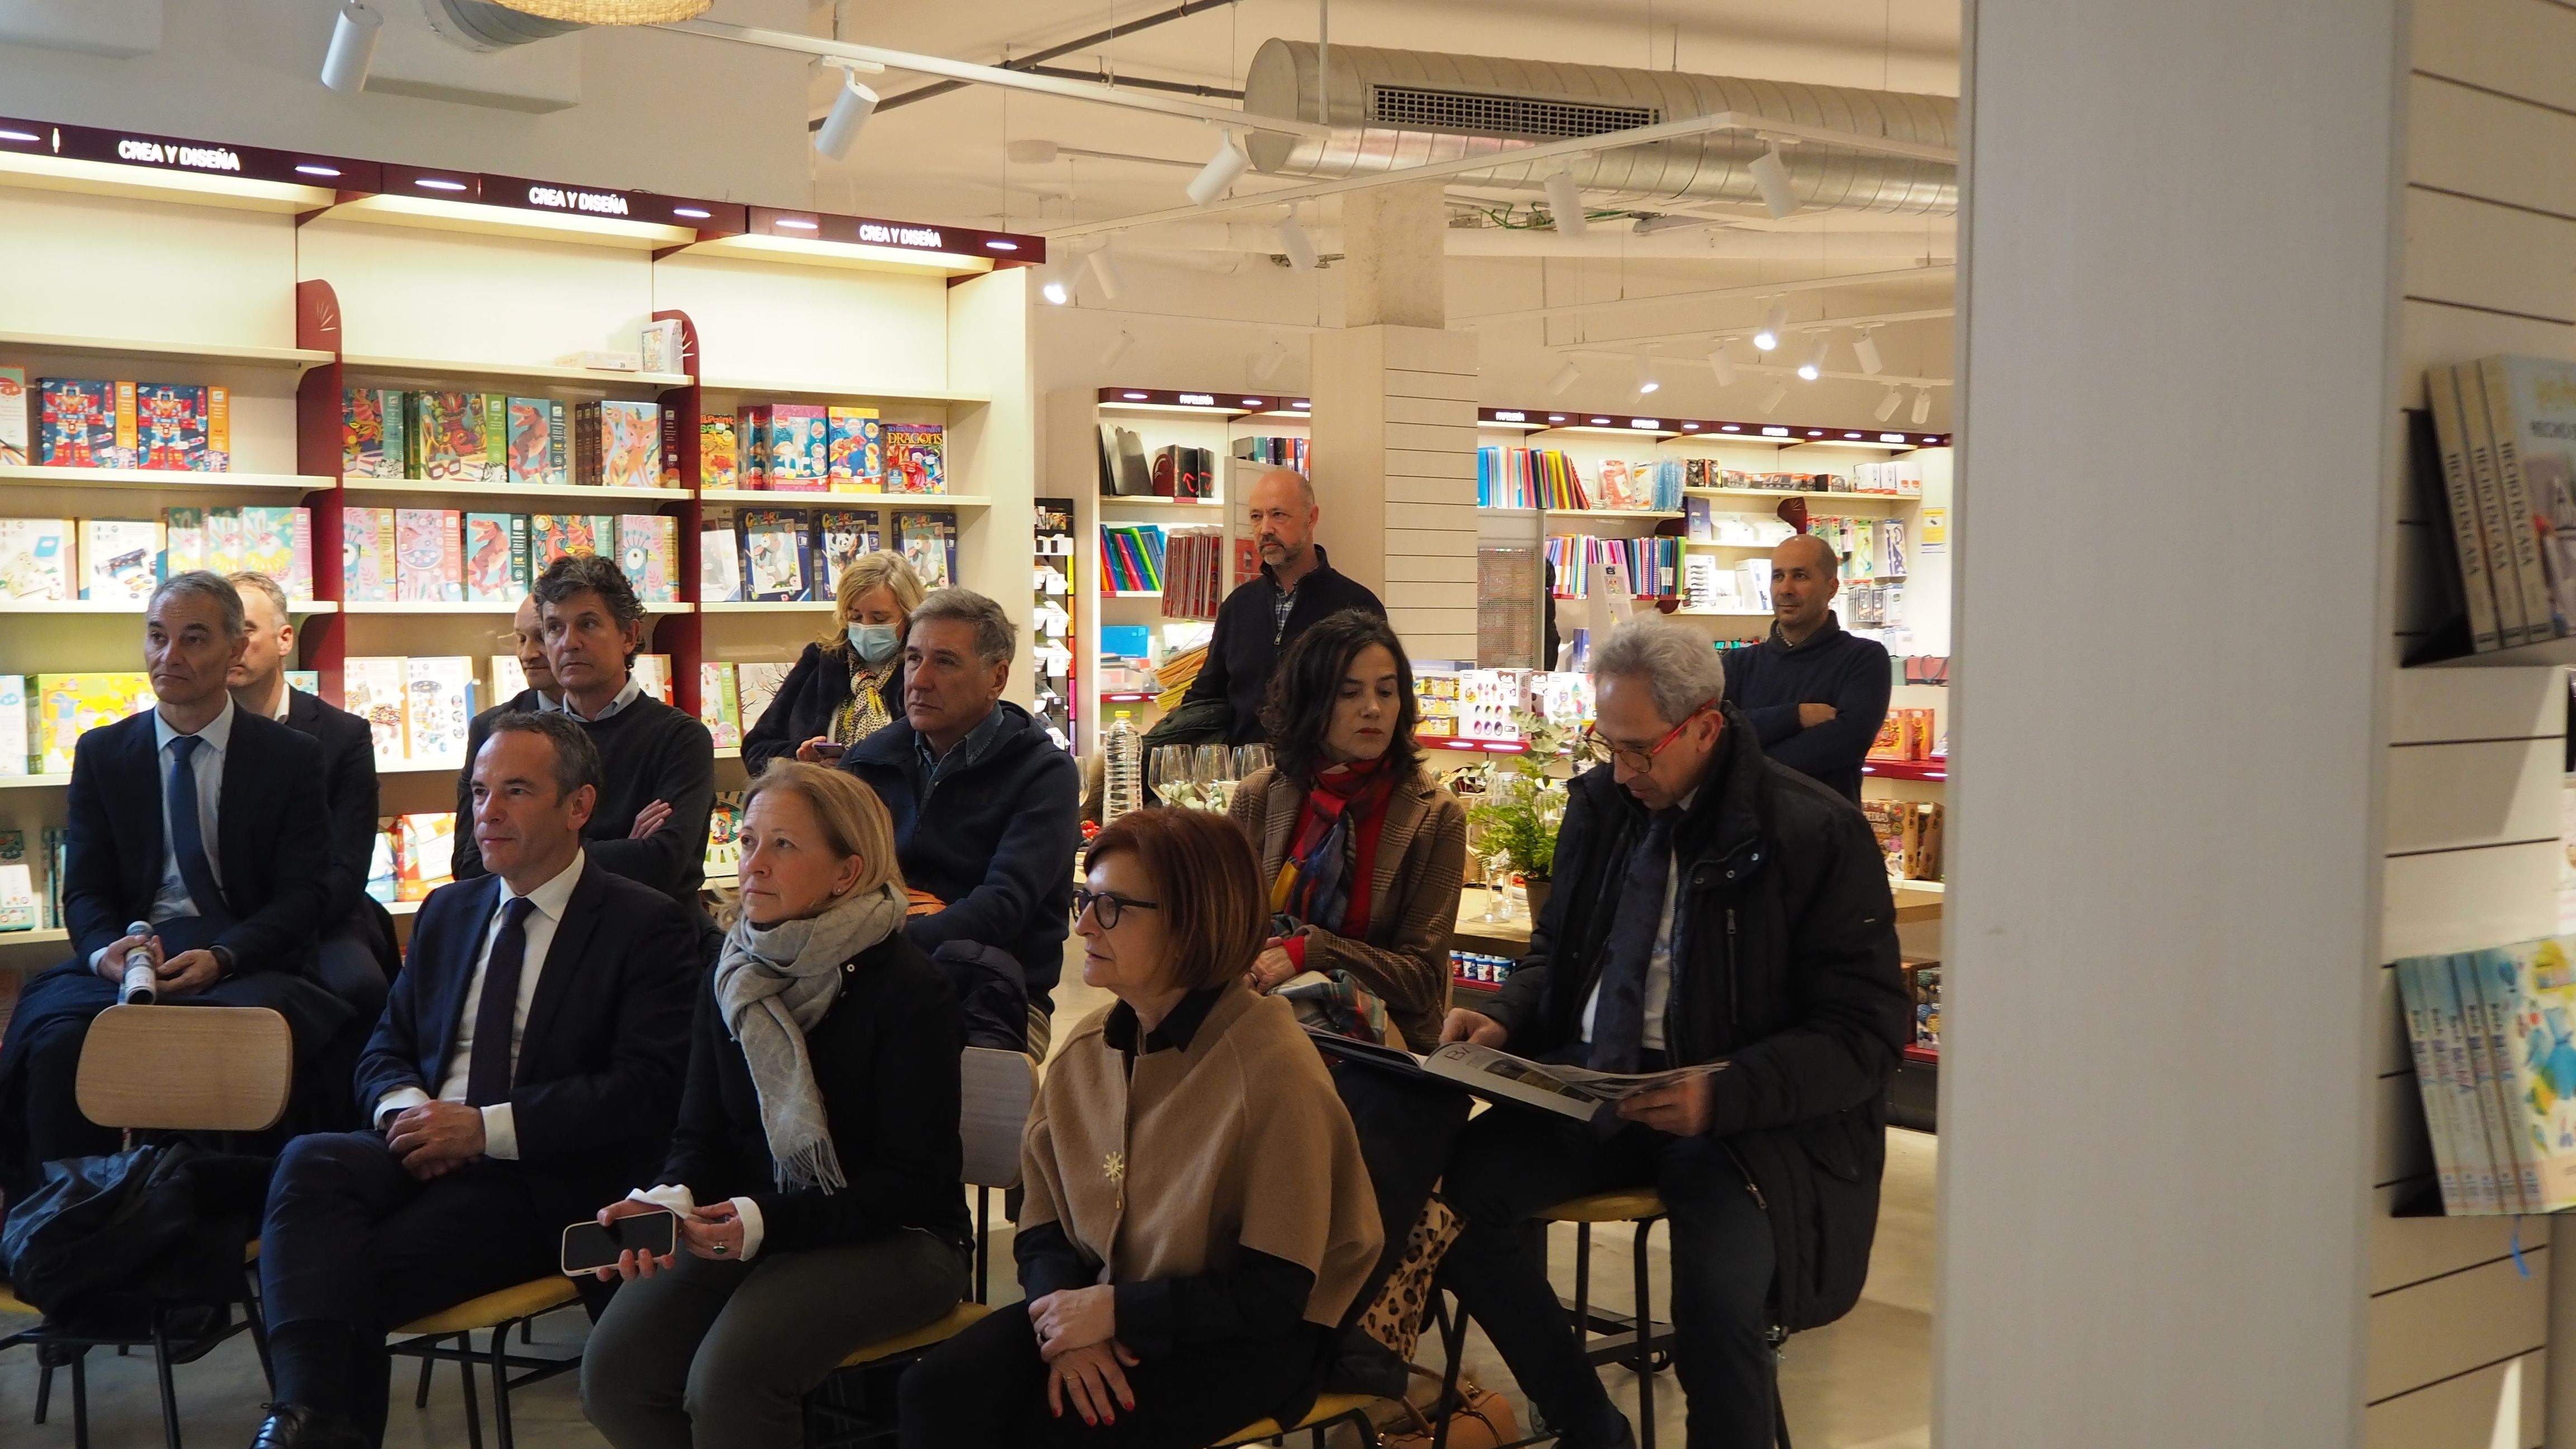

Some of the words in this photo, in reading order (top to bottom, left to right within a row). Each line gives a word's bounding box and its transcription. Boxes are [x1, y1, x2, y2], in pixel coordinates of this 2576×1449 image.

[118, 140, 164, 163] CREA
[164, 145, 178, 164] Y
[179, 146, 240, 171] DISEÑA
[529, 187, 566, 208] CREA
[566, 191, 578, 209] Y
[579, 192, 629, 215] DISEÑA
[859, 224, 890, 243] CREA
[889, 228, 901, 244] Y
[900, 228, 942, 248] DISEÑA
